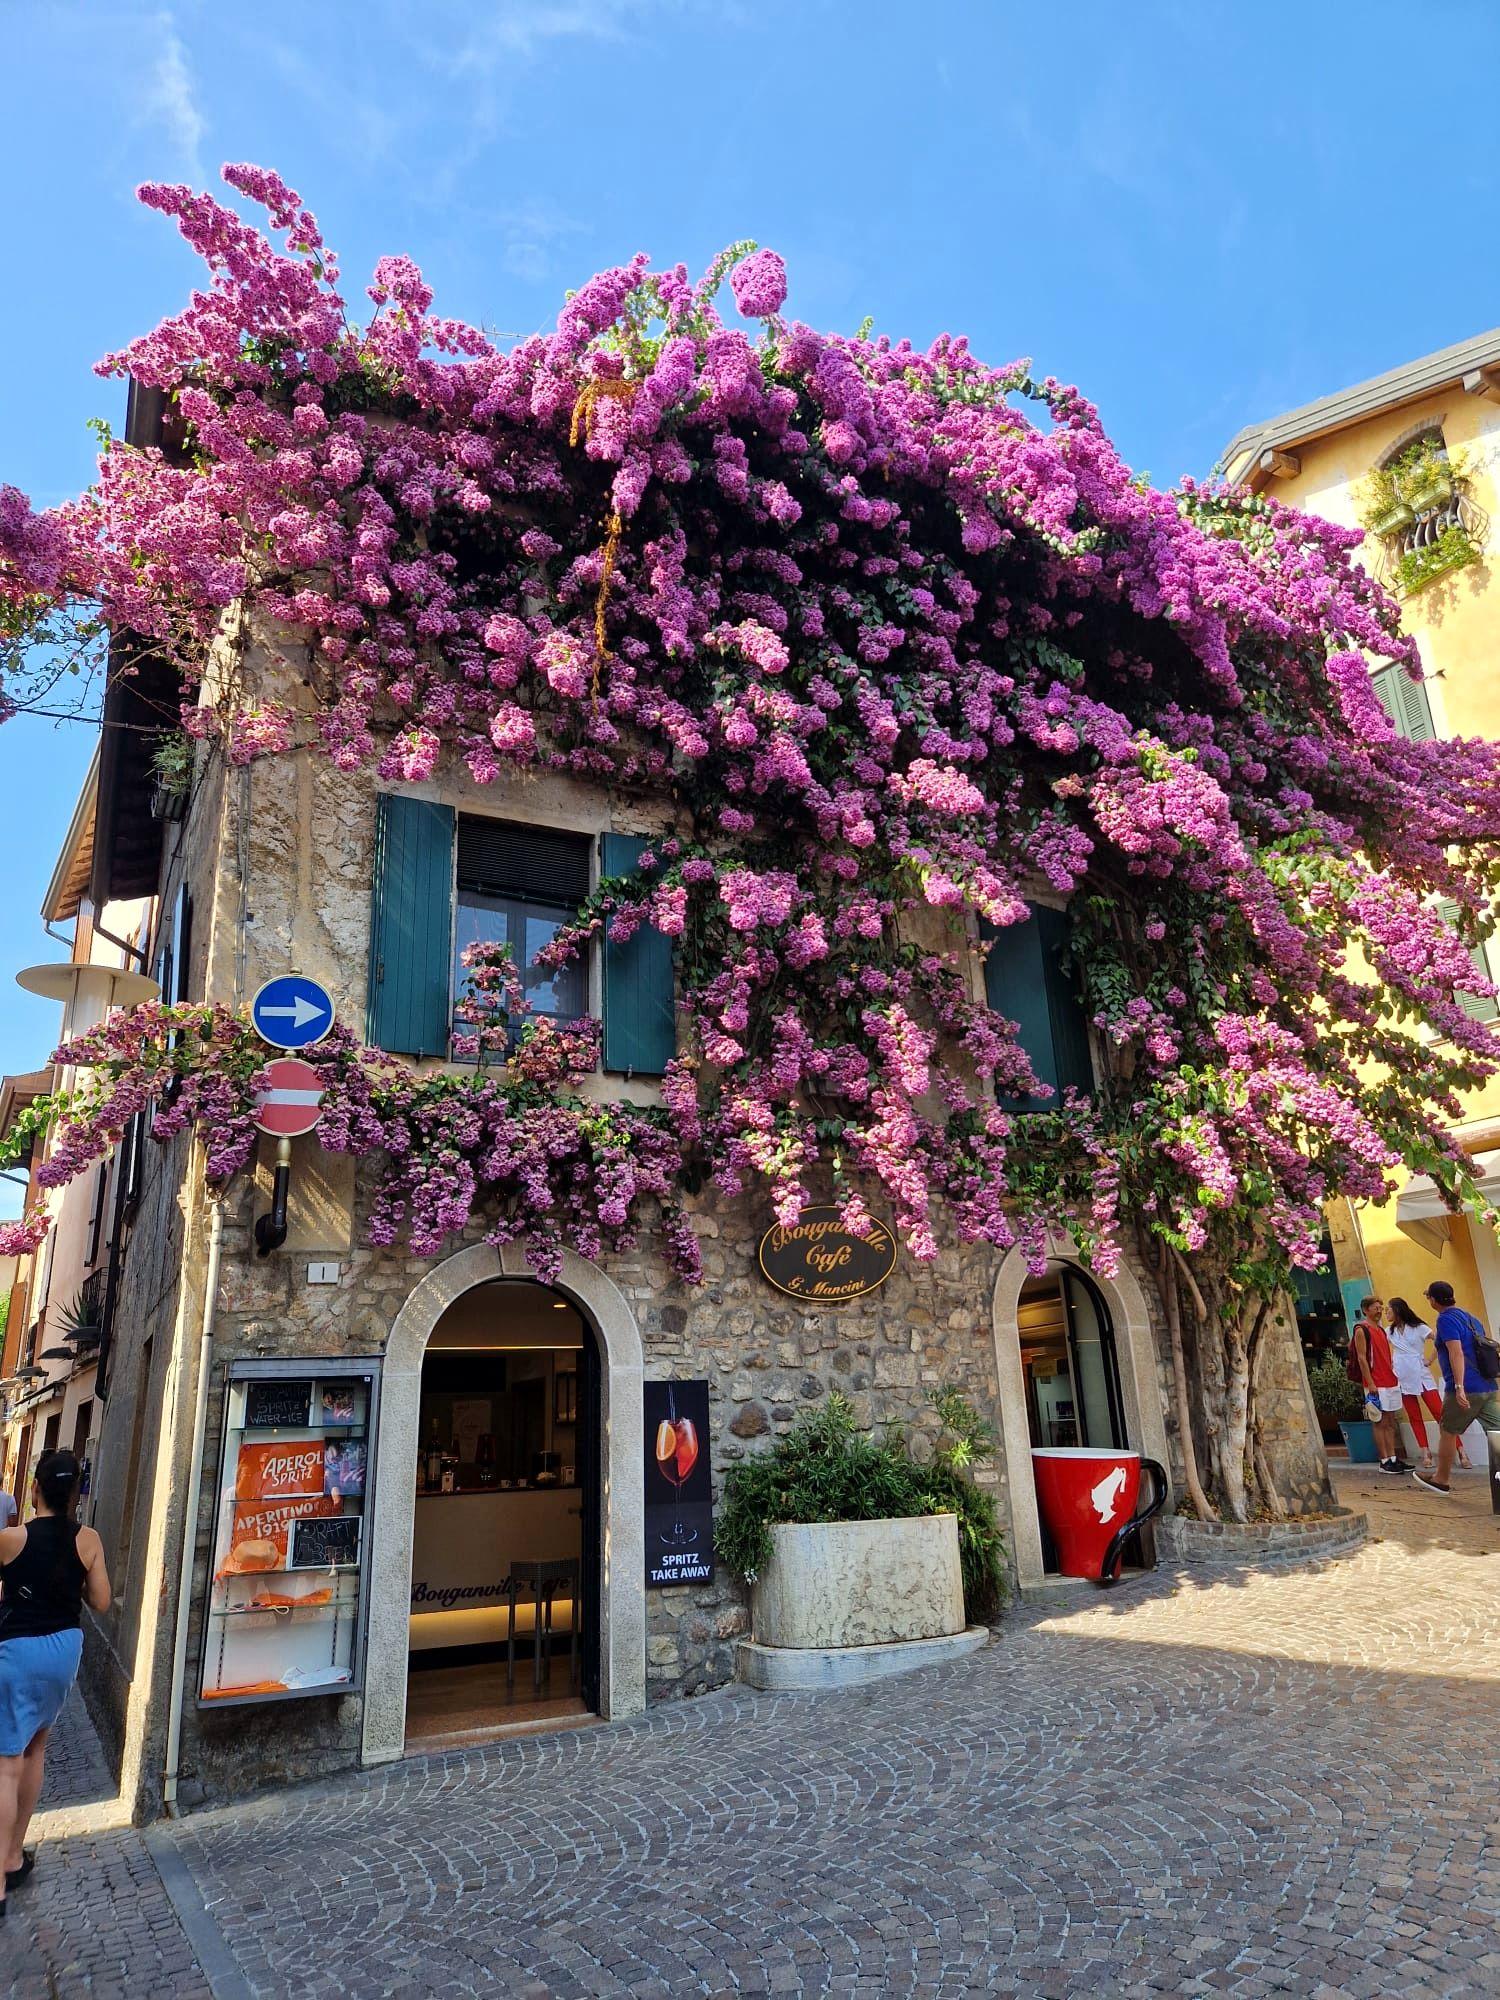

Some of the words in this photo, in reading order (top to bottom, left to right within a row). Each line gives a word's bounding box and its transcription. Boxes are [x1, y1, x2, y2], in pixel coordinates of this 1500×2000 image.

[772, 1221, 889, 1253] Bougalle
[788, 1275, 804, 1292] G.
[806, 1276, 865, 1296] Mancini
[262, 1451, 324, 1479] APEROL
[237, 1502, 314, 1531] APERITIVO
[255, 1519, 289, 1538] 1919
[662, 1553, 699, 1566] SPRITZ
[651, 1568, 678, 1581] TAKE
[680, 1565, 711, 1578] AWAY
